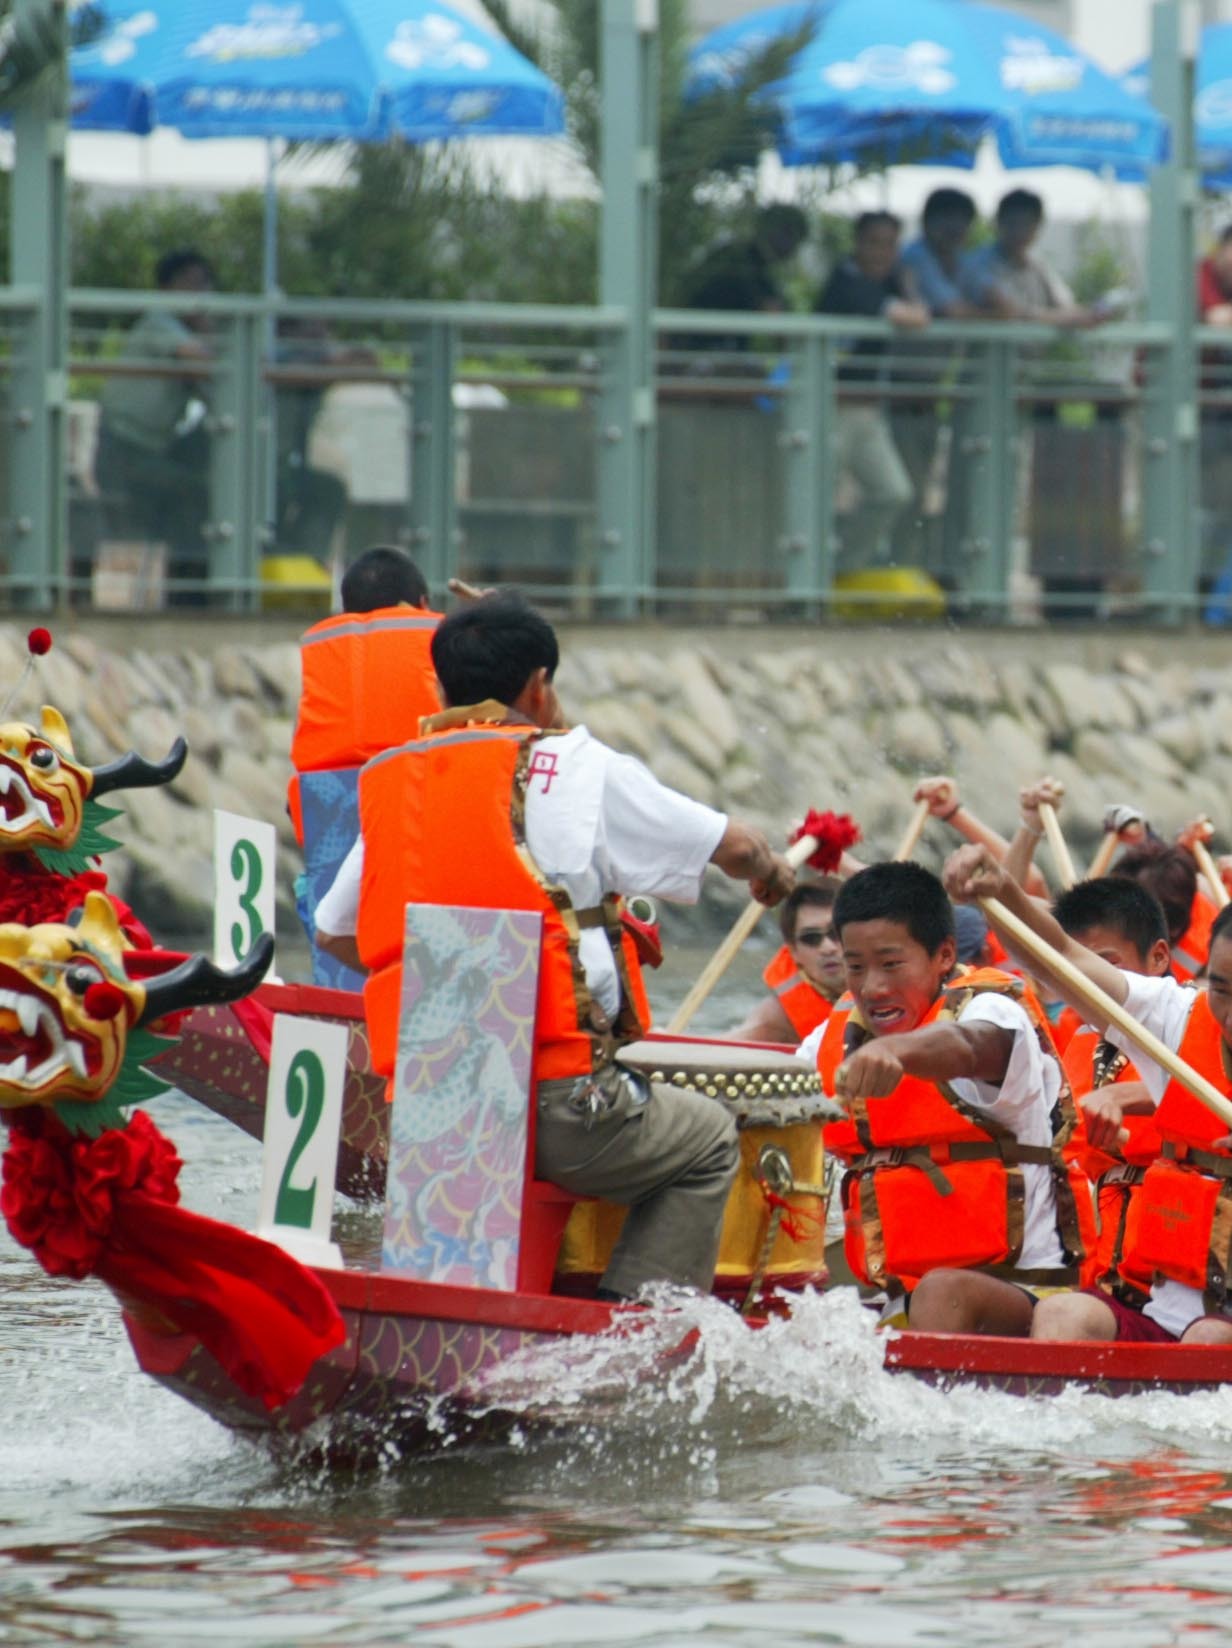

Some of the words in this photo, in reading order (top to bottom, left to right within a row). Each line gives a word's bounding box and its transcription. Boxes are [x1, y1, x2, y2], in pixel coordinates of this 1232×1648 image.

[528, 750, 558, 794] 丹
[231, 839, 263, 961] 3
[275, 1049, 325, 1229] 2
